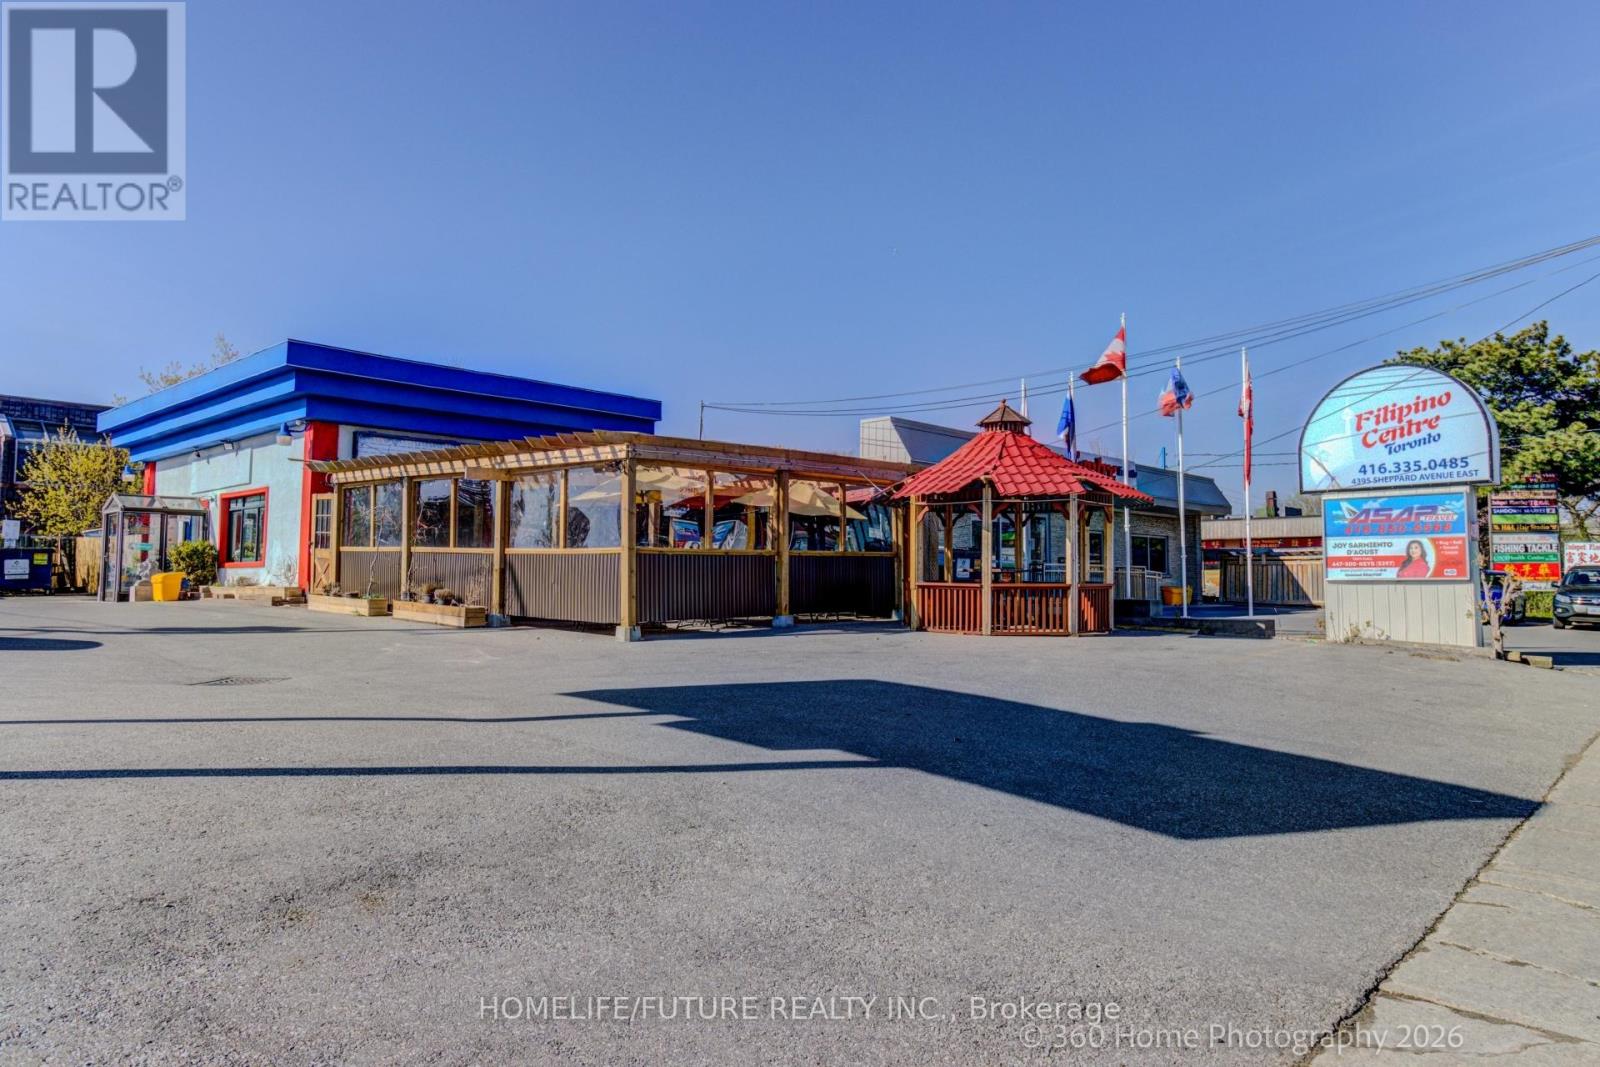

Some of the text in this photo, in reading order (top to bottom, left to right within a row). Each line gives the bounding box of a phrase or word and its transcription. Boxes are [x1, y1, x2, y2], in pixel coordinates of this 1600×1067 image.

[1355, 391, 1451, 432] Filipino
[1362, 414, 1441, 448] Centre
[1384, 432, 1441, 455] Toronto
[1358, 457, 1469, 475] 416.335.0485
[1374, 473, 1417, 483] SHEPPARD
[1420, 471, 1454, 480] AVENUE
[1457, 469, 1479, 477] EAST
[1347, 505, 1439, 524] ASAP
[1493, 544, 1525, 553] FISHING
[1527, 543, 1558, 553] TACKLE
